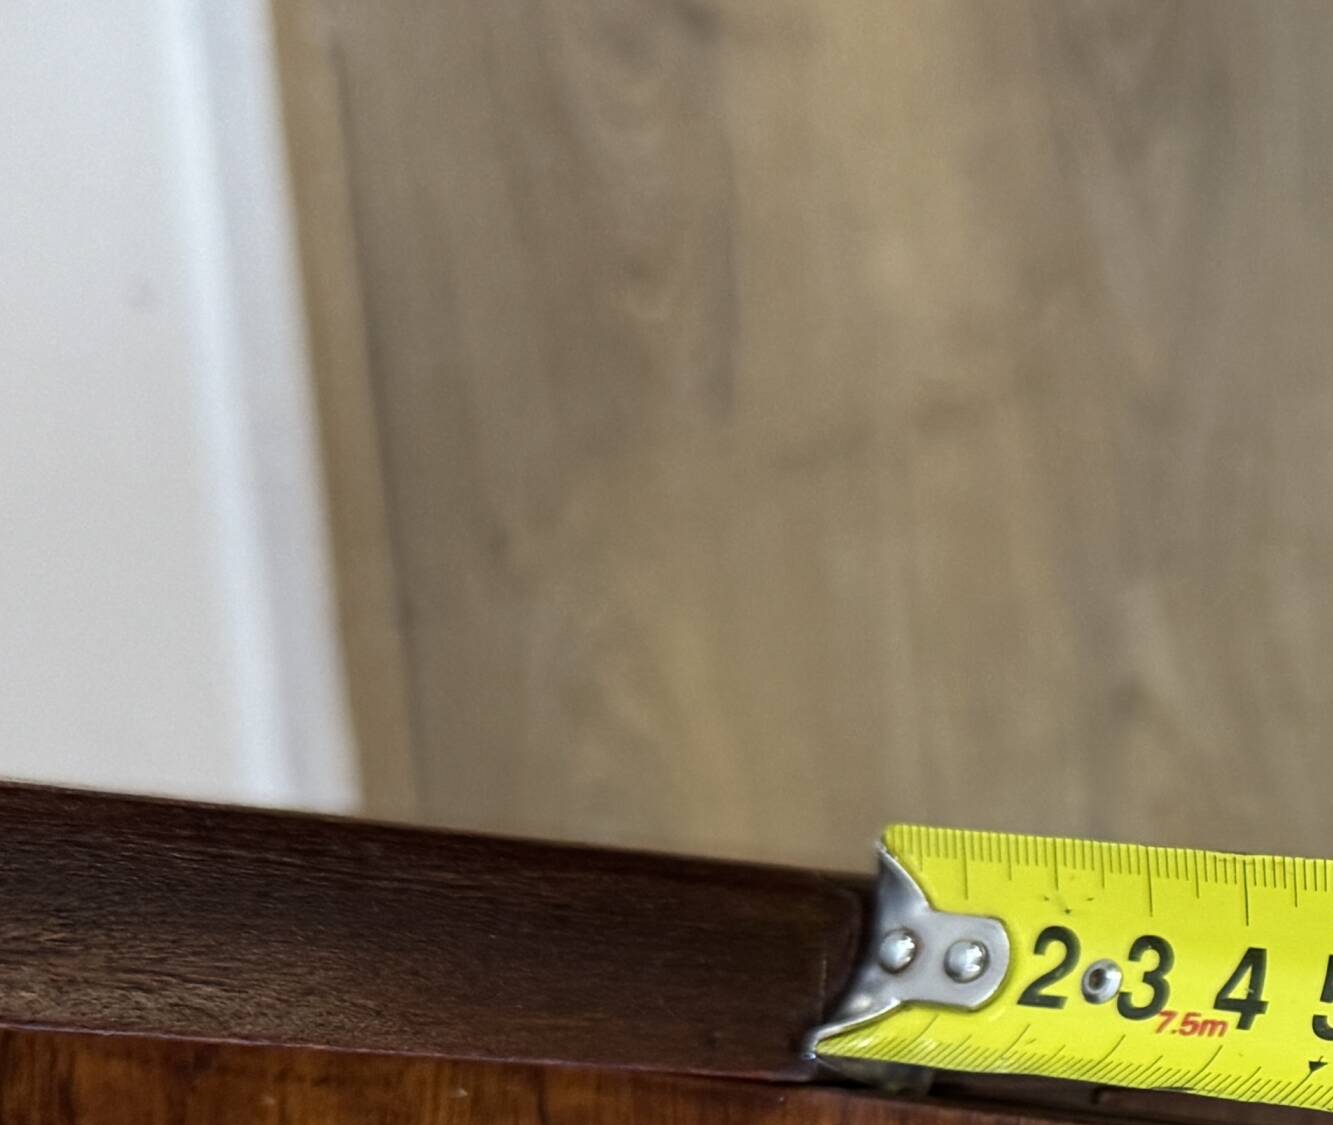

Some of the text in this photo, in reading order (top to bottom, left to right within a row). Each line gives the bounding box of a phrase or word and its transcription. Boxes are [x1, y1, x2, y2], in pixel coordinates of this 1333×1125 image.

[1018, 926, 1078, 1008] 2
[1117, 935, 1173, 1020] 3
[1214, 947, 1267, 1030] 4
[1156, 1009, 1229, 1038] 7.5m
